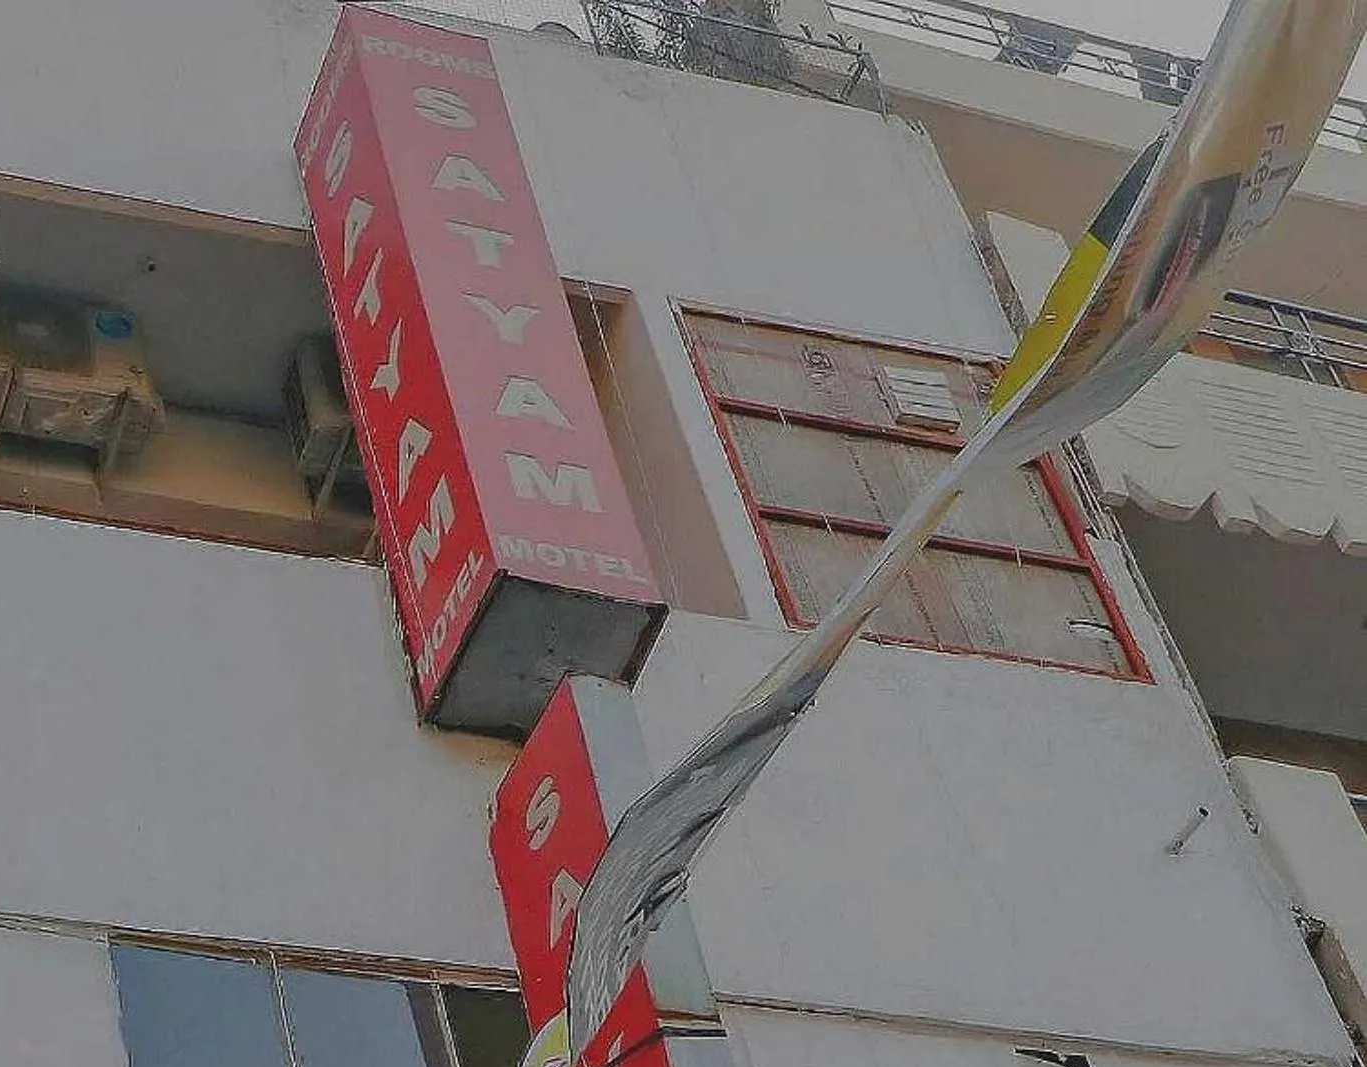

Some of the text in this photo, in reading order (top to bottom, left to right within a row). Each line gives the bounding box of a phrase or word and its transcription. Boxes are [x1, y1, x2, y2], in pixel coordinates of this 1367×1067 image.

[361, 35, 496, 80] ROOMS
[324, 117, 456, 590] SATYAM
[412, 85, 604, 514] SATYAM
[416, 550, 483, 684] MOTEL
[497, 533, 650, 584] MOTEL
